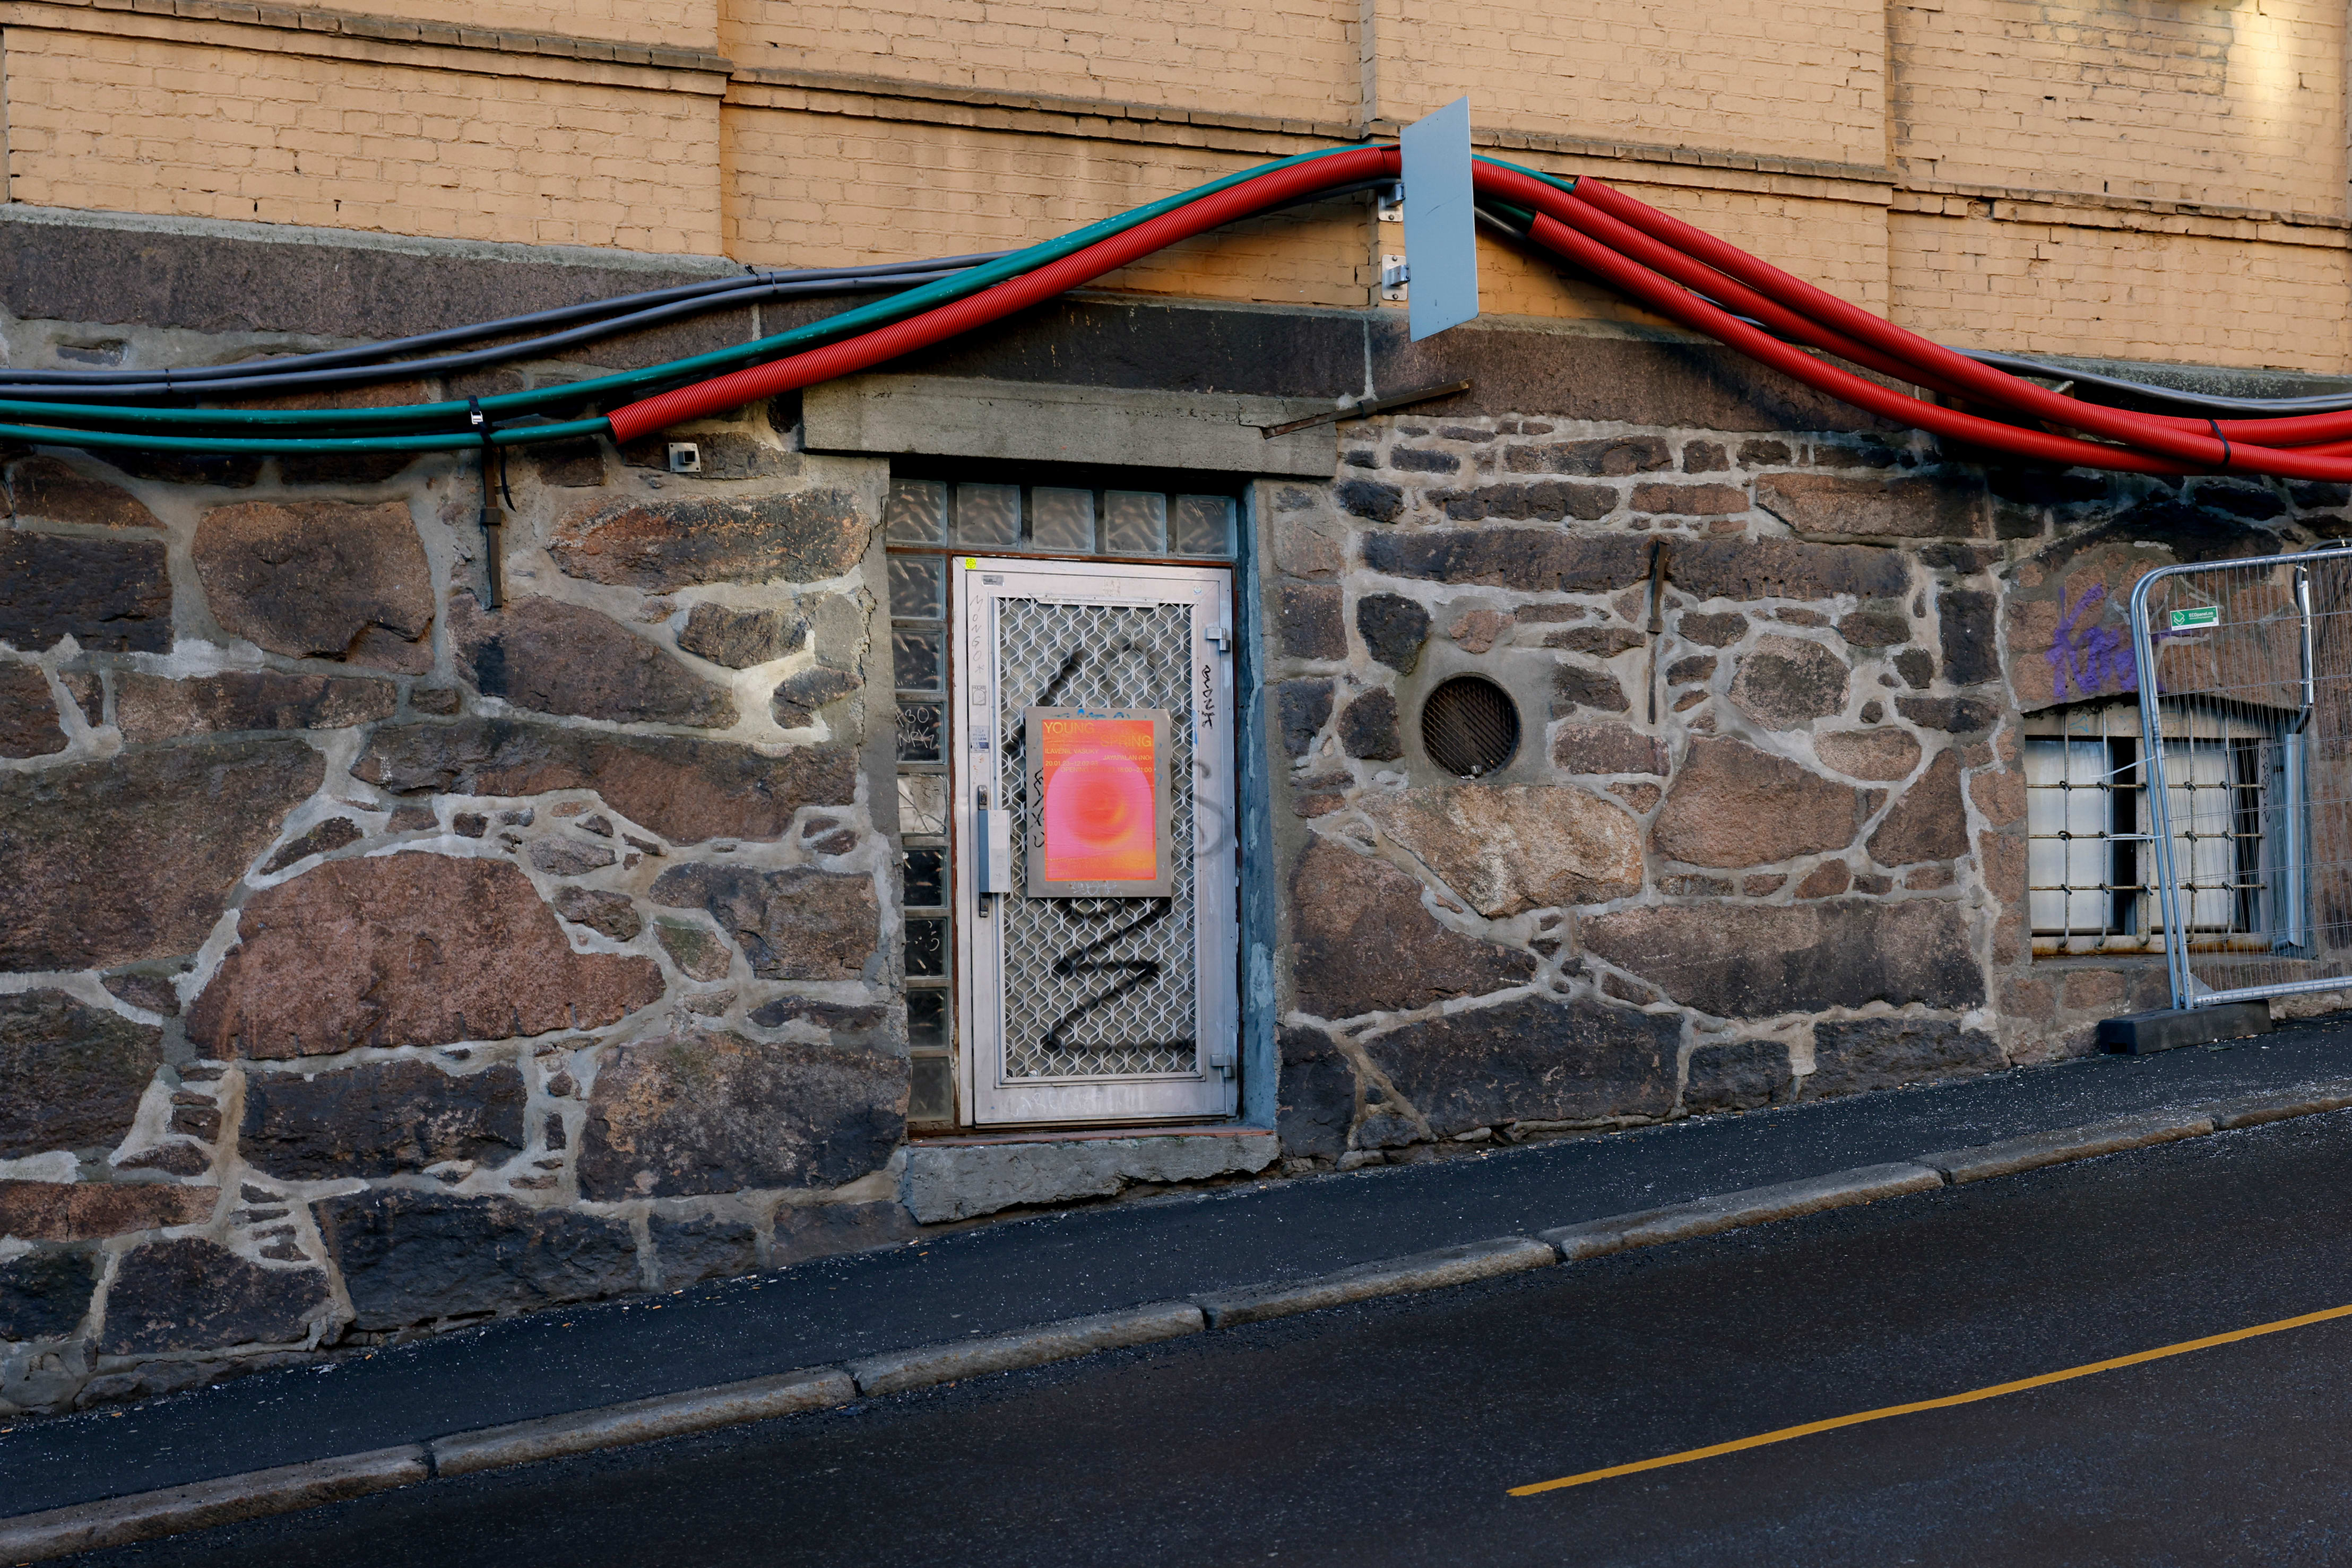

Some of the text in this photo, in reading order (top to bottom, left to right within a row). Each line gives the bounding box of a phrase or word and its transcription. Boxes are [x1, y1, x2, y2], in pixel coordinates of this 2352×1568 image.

[970, 594, 983, 662] MONGO
[1044, 722, 1095, 734] YOUNG
[1100, 735, 1152, 747] SPRING
